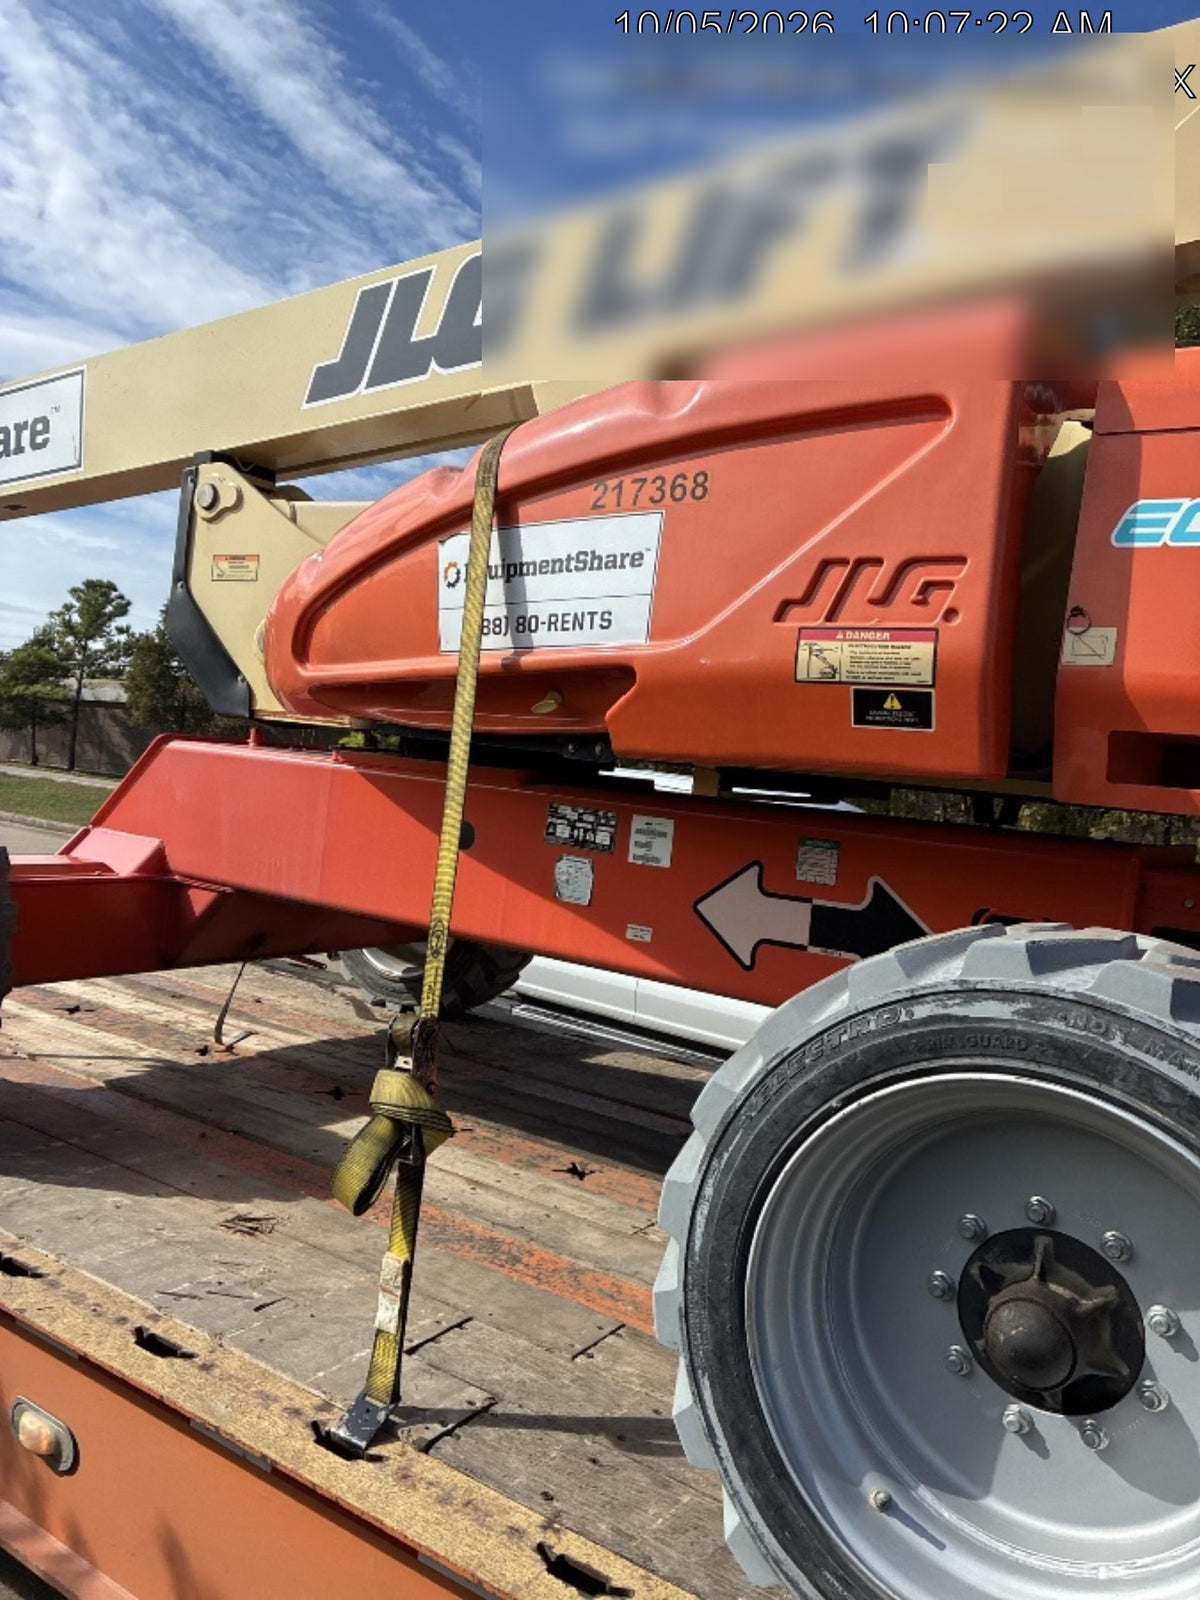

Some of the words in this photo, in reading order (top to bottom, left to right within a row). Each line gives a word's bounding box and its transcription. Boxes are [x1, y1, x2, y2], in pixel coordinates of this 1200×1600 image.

[590, 470, 710, 511] 217368
[463, 550, 645, 584] uipmentShare
[772, 556, 970, 625] JLG
[481, 615, 510, 637] 88)
[515, 610, 613, 634] 80-RENTS
[845, 631, 890, 641] DANGER
